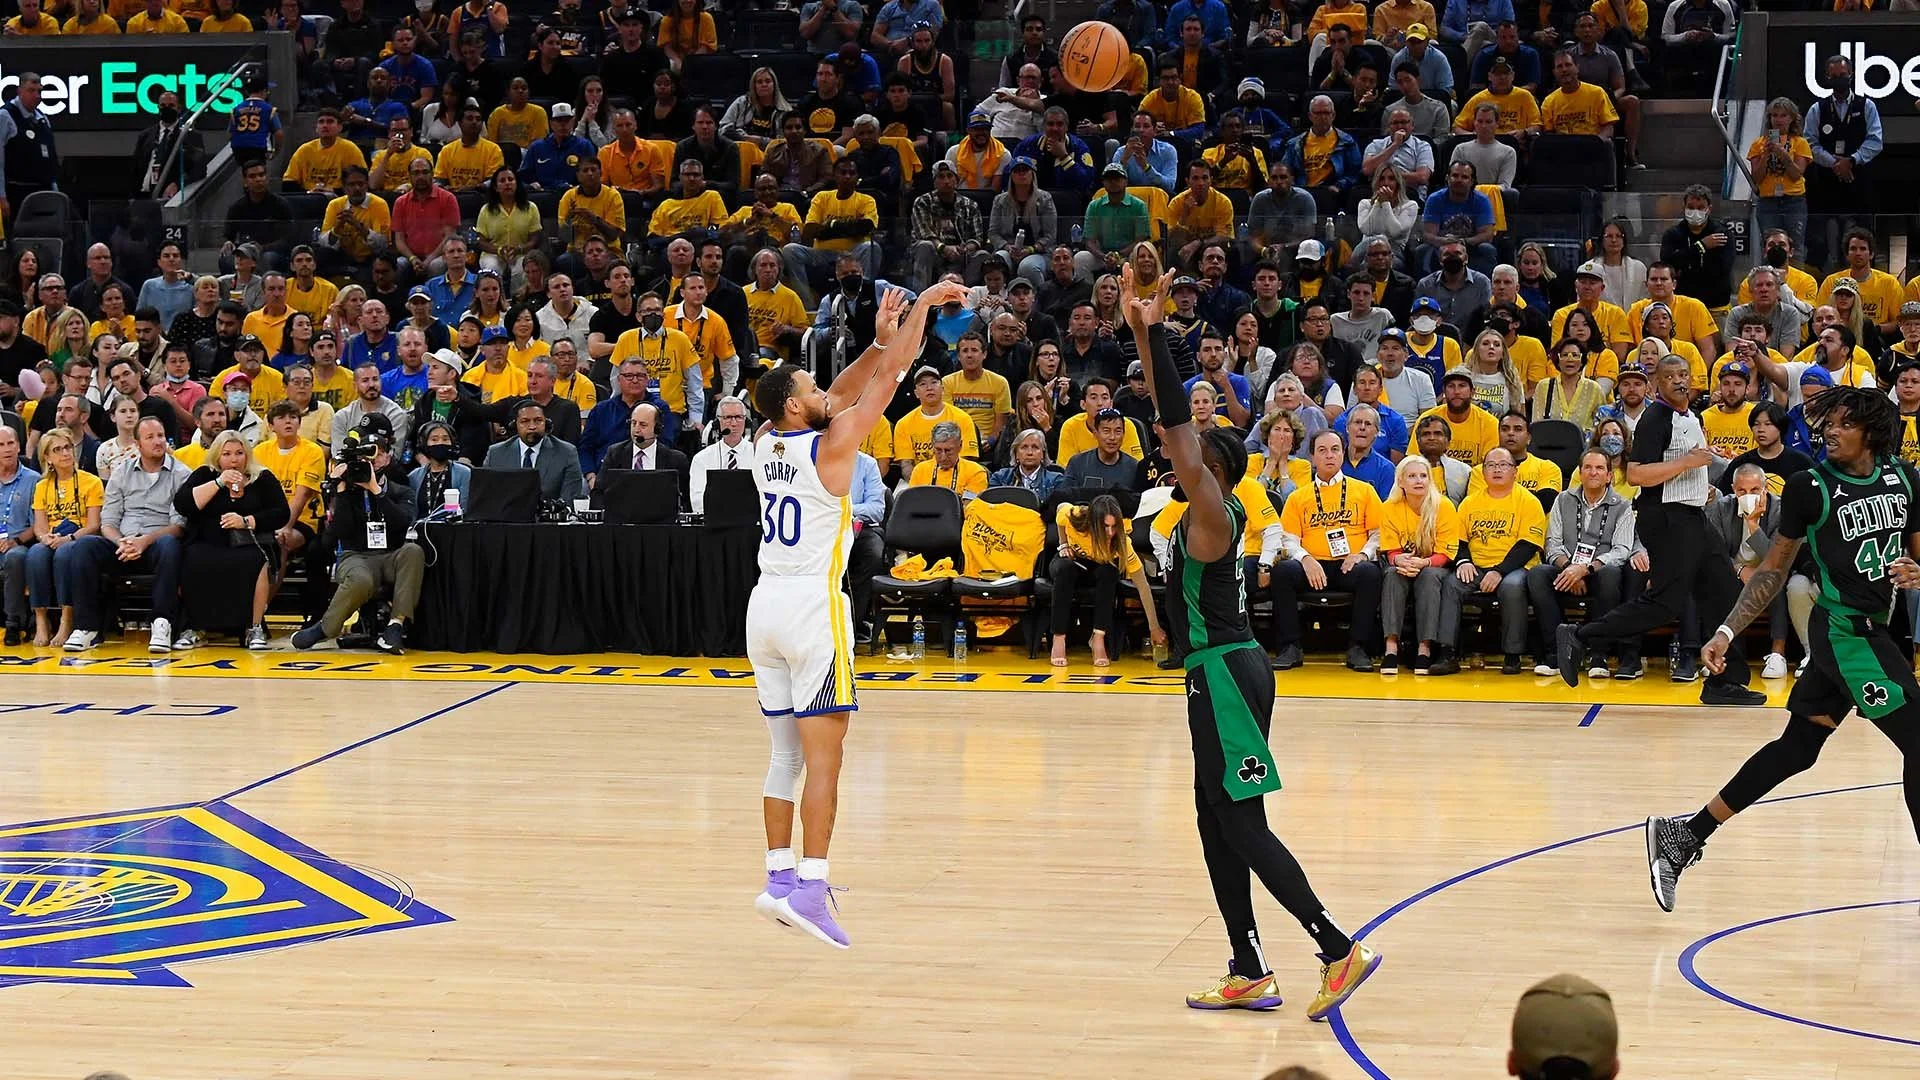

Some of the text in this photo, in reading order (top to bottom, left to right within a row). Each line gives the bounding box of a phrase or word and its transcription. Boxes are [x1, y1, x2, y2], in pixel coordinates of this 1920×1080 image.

[101, 62, 245, 114] Eats
[237, 115, 260, 132] 35
[166, 228, 182, 239] 24
[1726, 221, 1745, 234] 26
[1711, 436, 1750, 445] BLOODED
[764, 461, 798, 485] CURRY
[1147, 467, 1158, 480] 30
[763, 492, 802, 547] 30
[1837, 494, 1908, 542] CELTICS
[1855, 531, 1903, 582] 44
[268, 660, 381, 672] 75
[413, 664, 1187, 687] CELEBATING
